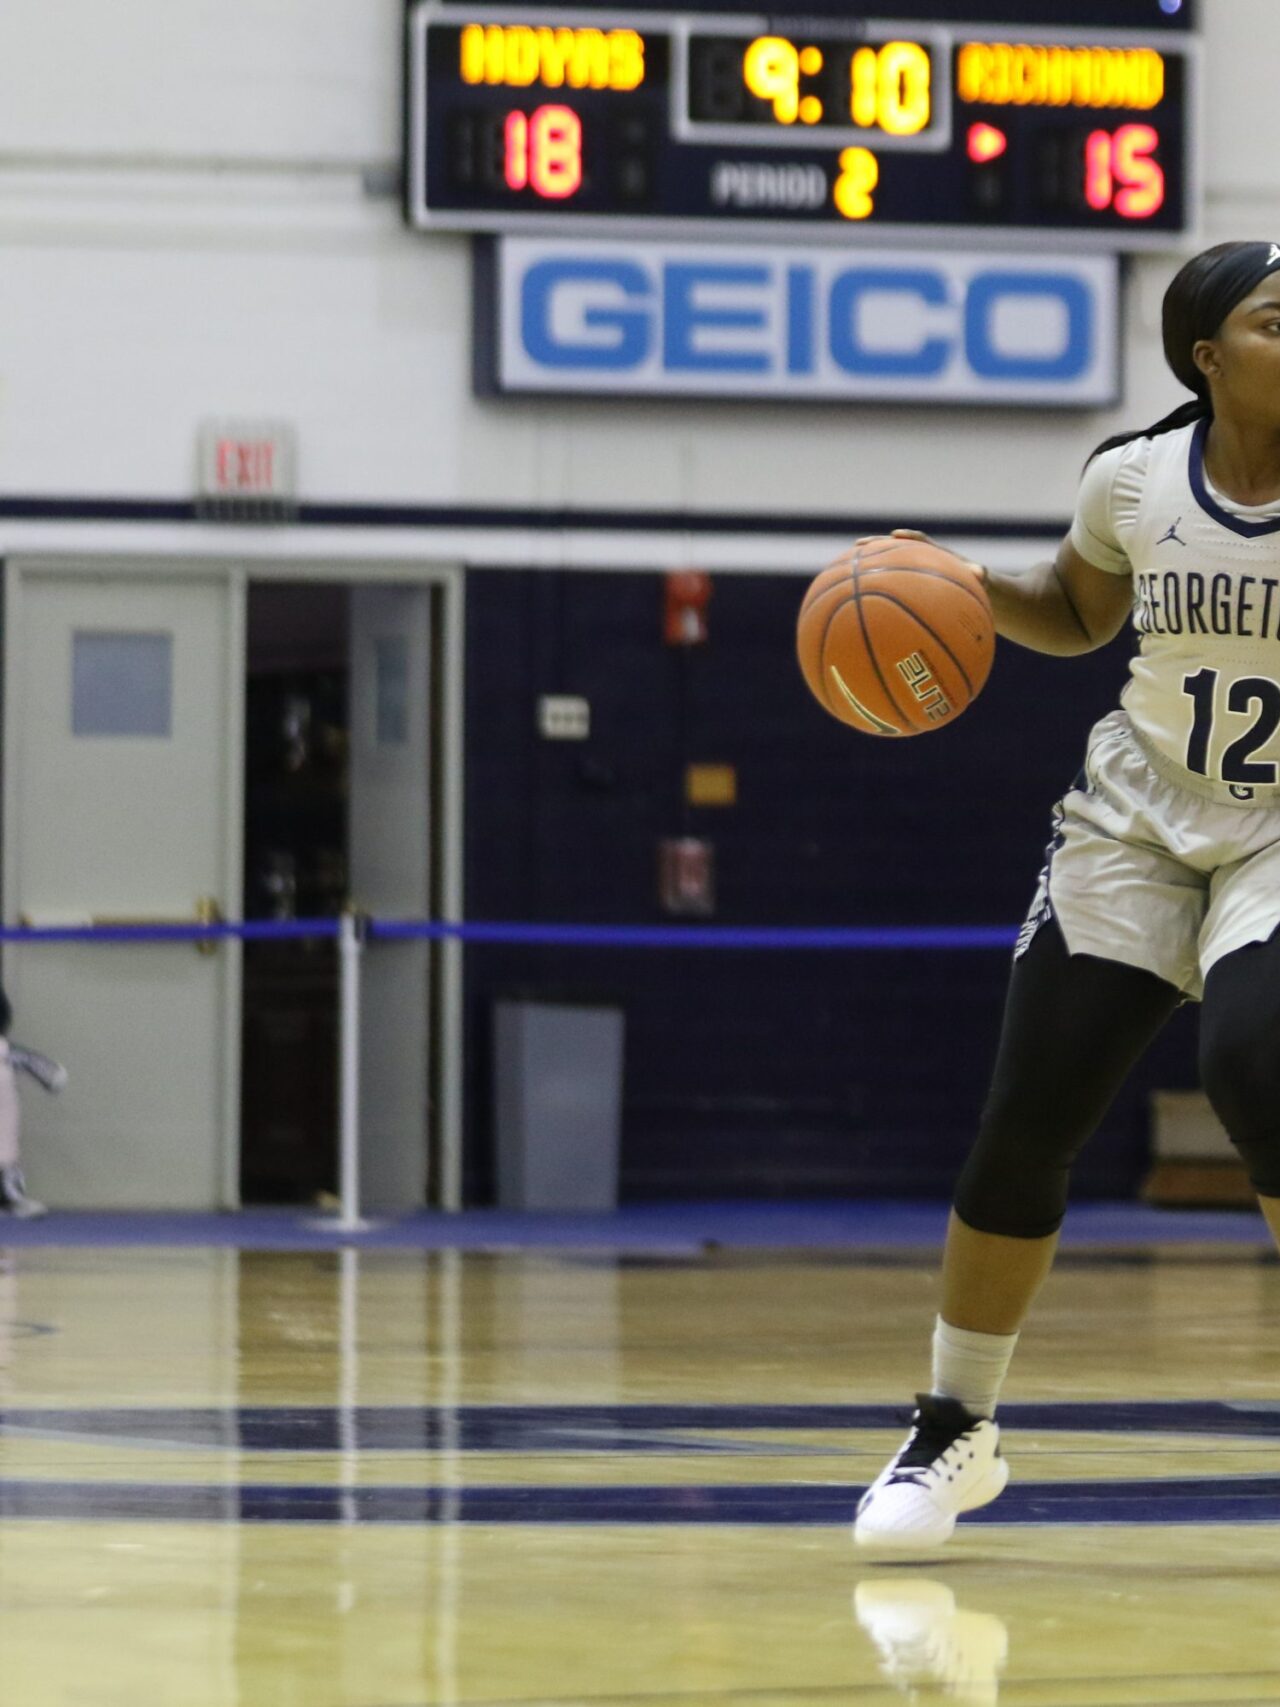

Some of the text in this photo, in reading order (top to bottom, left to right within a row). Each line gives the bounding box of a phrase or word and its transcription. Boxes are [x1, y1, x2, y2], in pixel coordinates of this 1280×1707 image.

[743, 35, 930, 136] 9:10
[958, 42, 1165, 110] RICHMOND
[504, 104, 582, 198] 18
[710, 146, 879, 219] PERIOD 2
[1085, 123, 1165, 218] 15
[520, 257, 1095, 382] GEICO
[215, 439, 273, 488] EXIT
[896, 652, 951, 722] ELITE
